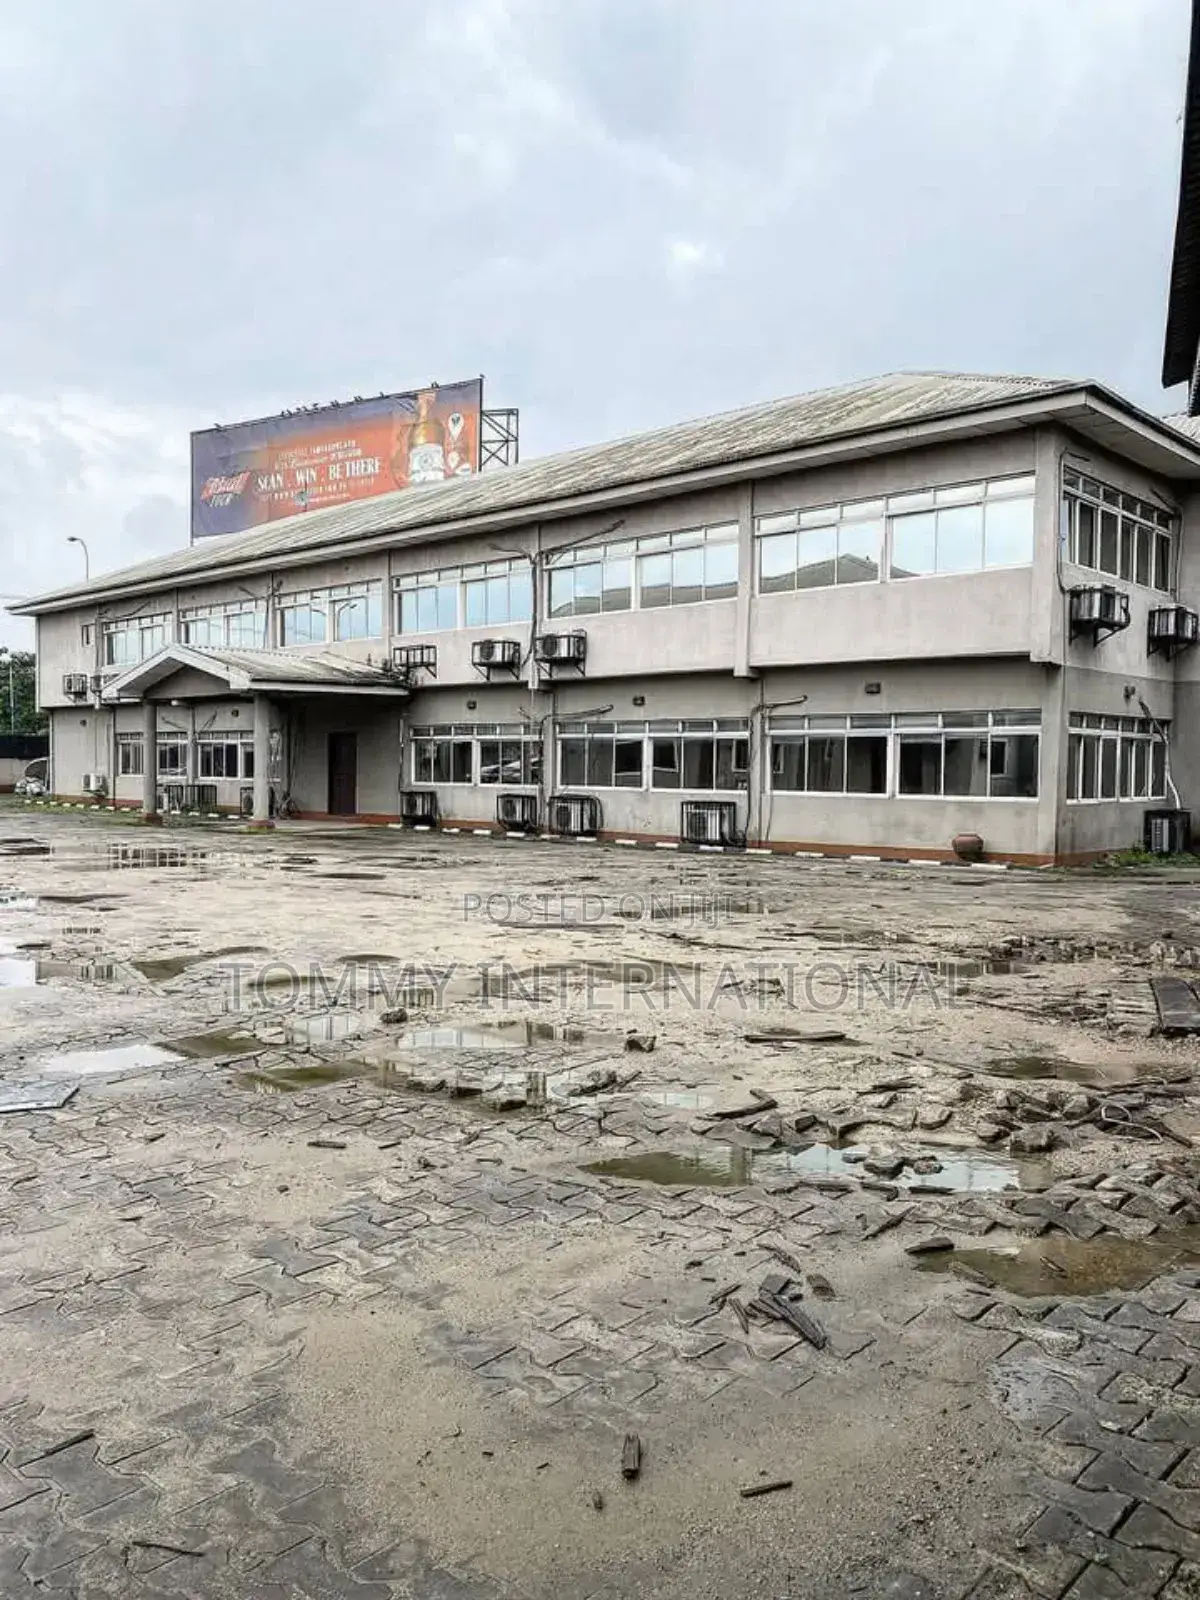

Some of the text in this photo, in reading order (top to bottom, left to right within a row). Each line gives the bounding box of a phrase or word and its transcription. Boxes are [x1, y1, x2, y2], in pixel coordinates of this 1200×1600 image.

[257, 473, 284, 492] SCAN
[295, 466, 317, 484] WIN
[329, 463, 343, 481] BE
[344, 457, 380, 477] THERE
